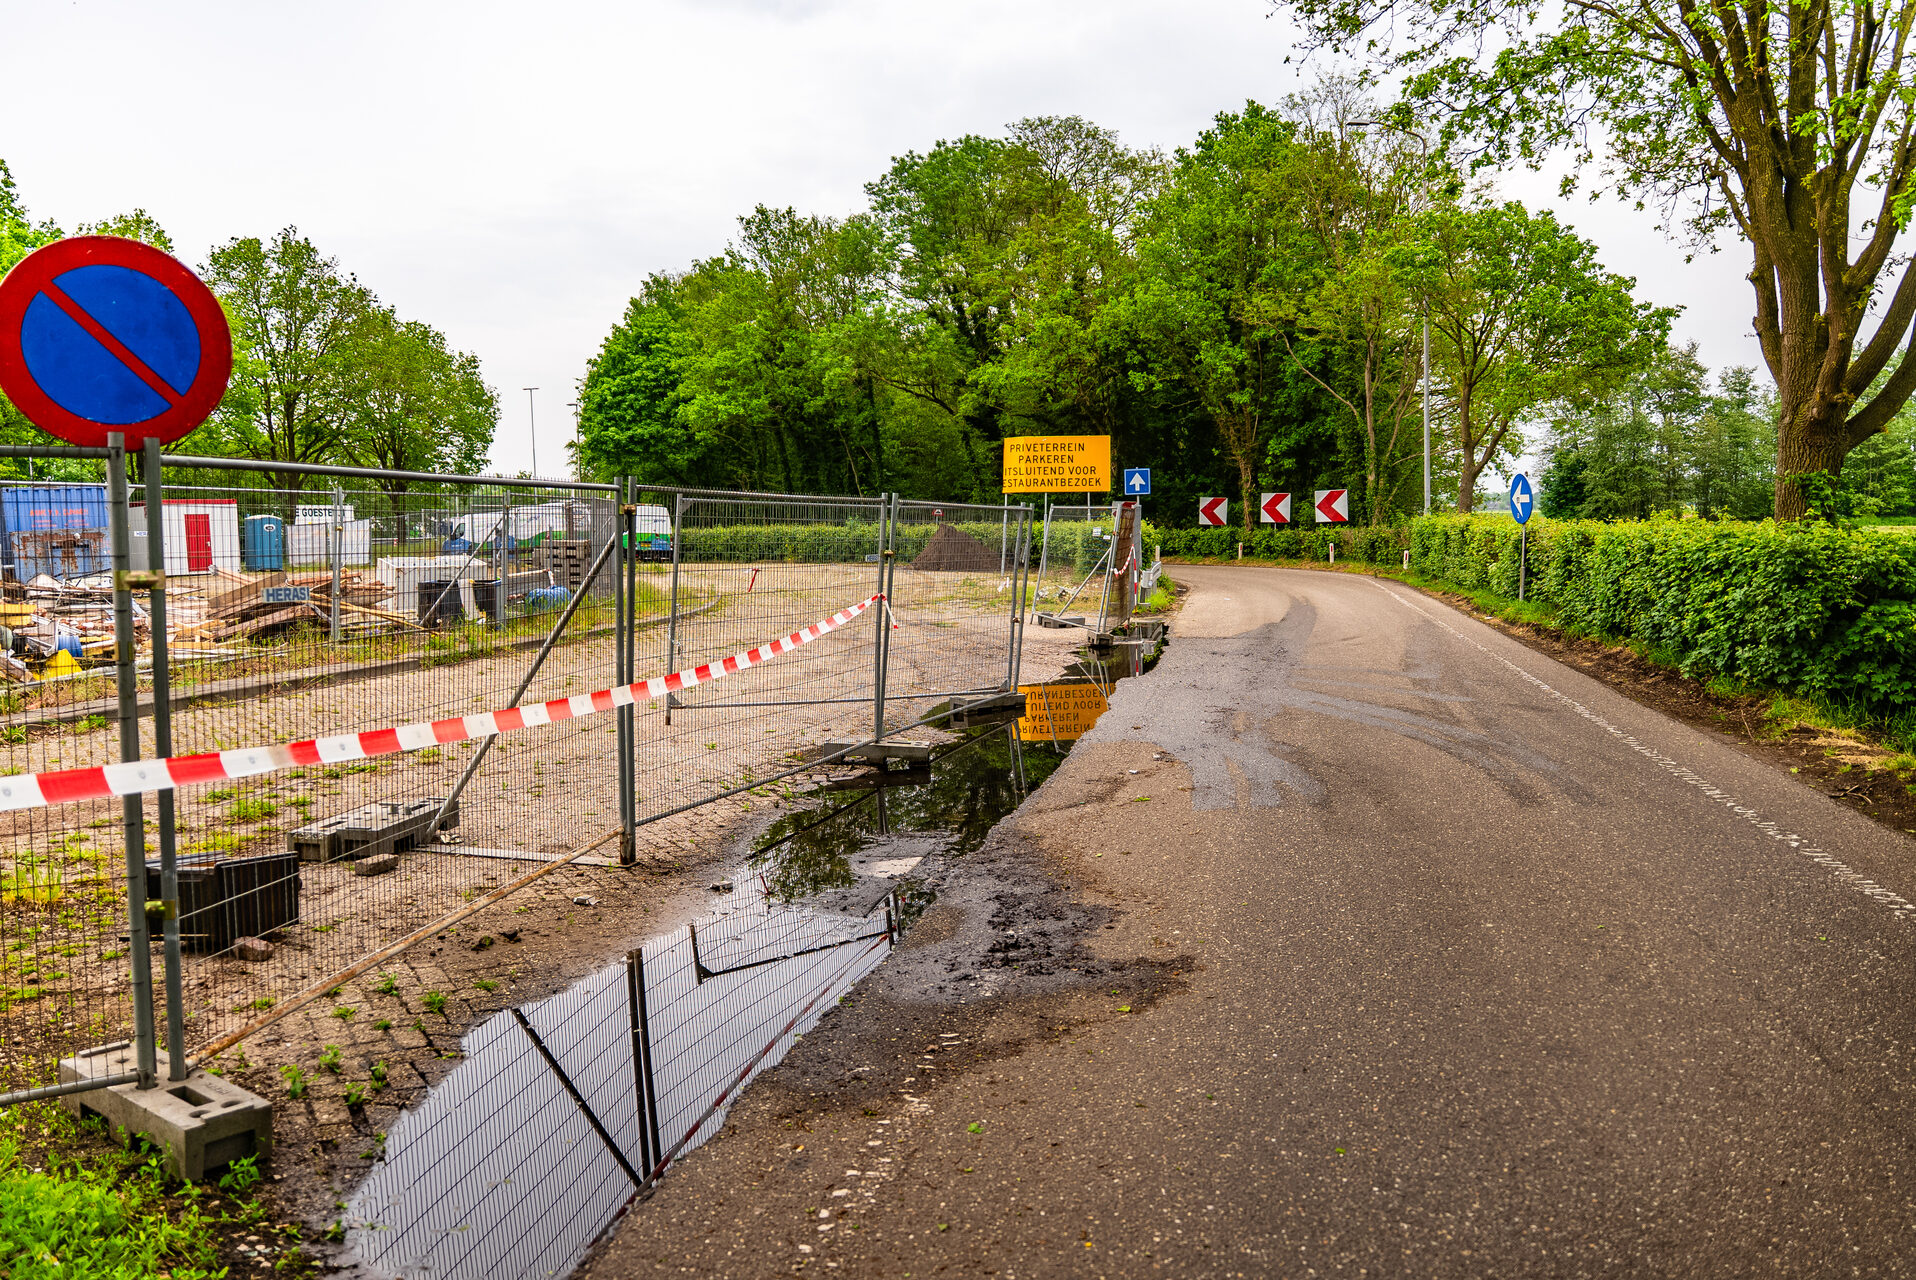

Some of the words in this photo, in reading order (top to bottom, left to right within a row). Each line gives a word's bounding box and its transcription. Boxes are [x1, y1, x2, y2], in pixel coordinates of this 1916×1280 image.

[1010, 443, 1085, 452] PRIVETERREIN
[1019, 455, 1074, 463] PARKEREN
[1004, 466, 1065, 476] ITSLUITEND
[1068, 466, 1096, 475] VOOR
[1003, 478, 1101, 488] ESTAURANTBEZOEK
[266, 587, 306, 602] HERAS
